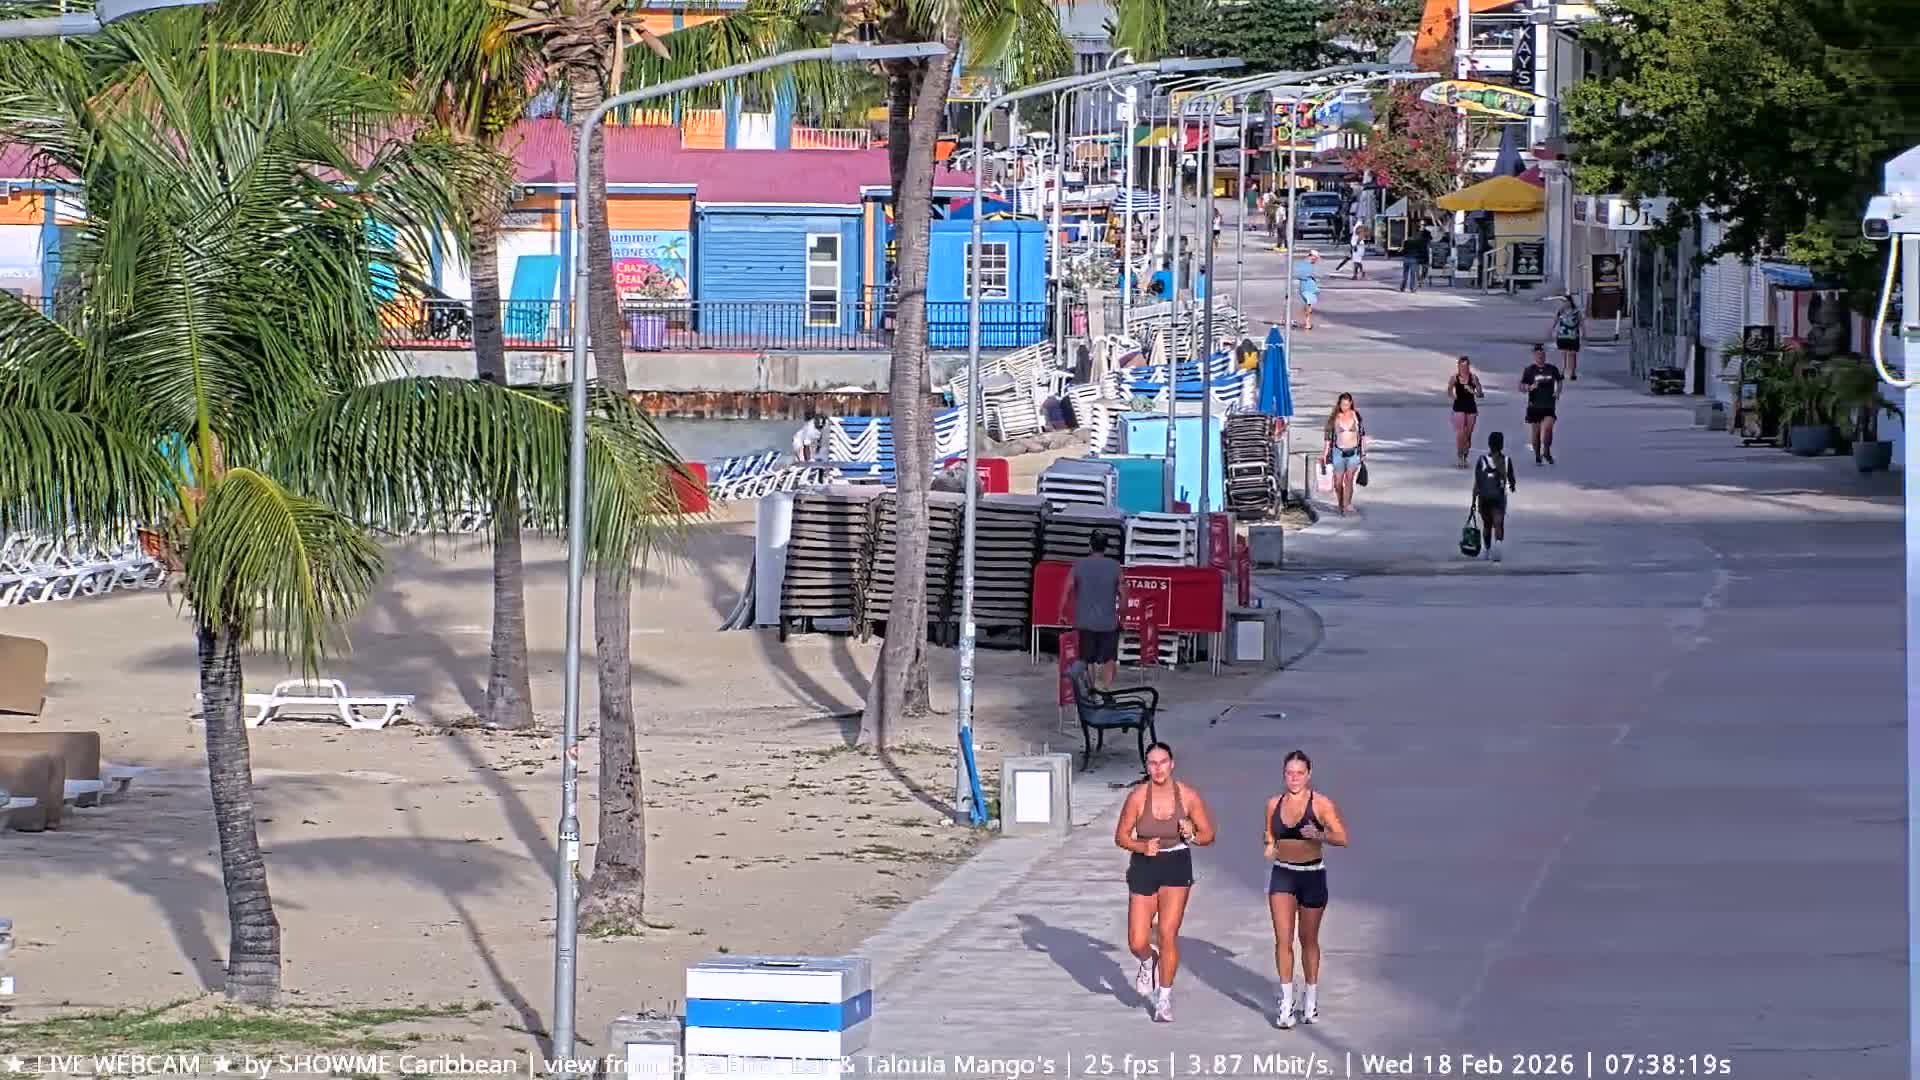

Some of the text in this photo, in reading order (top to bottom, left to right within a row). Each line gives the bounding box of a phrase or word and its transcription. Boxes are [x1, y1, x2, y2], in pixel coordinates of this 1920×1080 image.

[1518, 26, 1532, 84] KAY'S
[611, 234, 657, 243] ummer
[614, 247, 657, 257] ADNESS
[616, 273, 642, 284] DEAL
[1125, 579, 1168, 590] STARD'S
